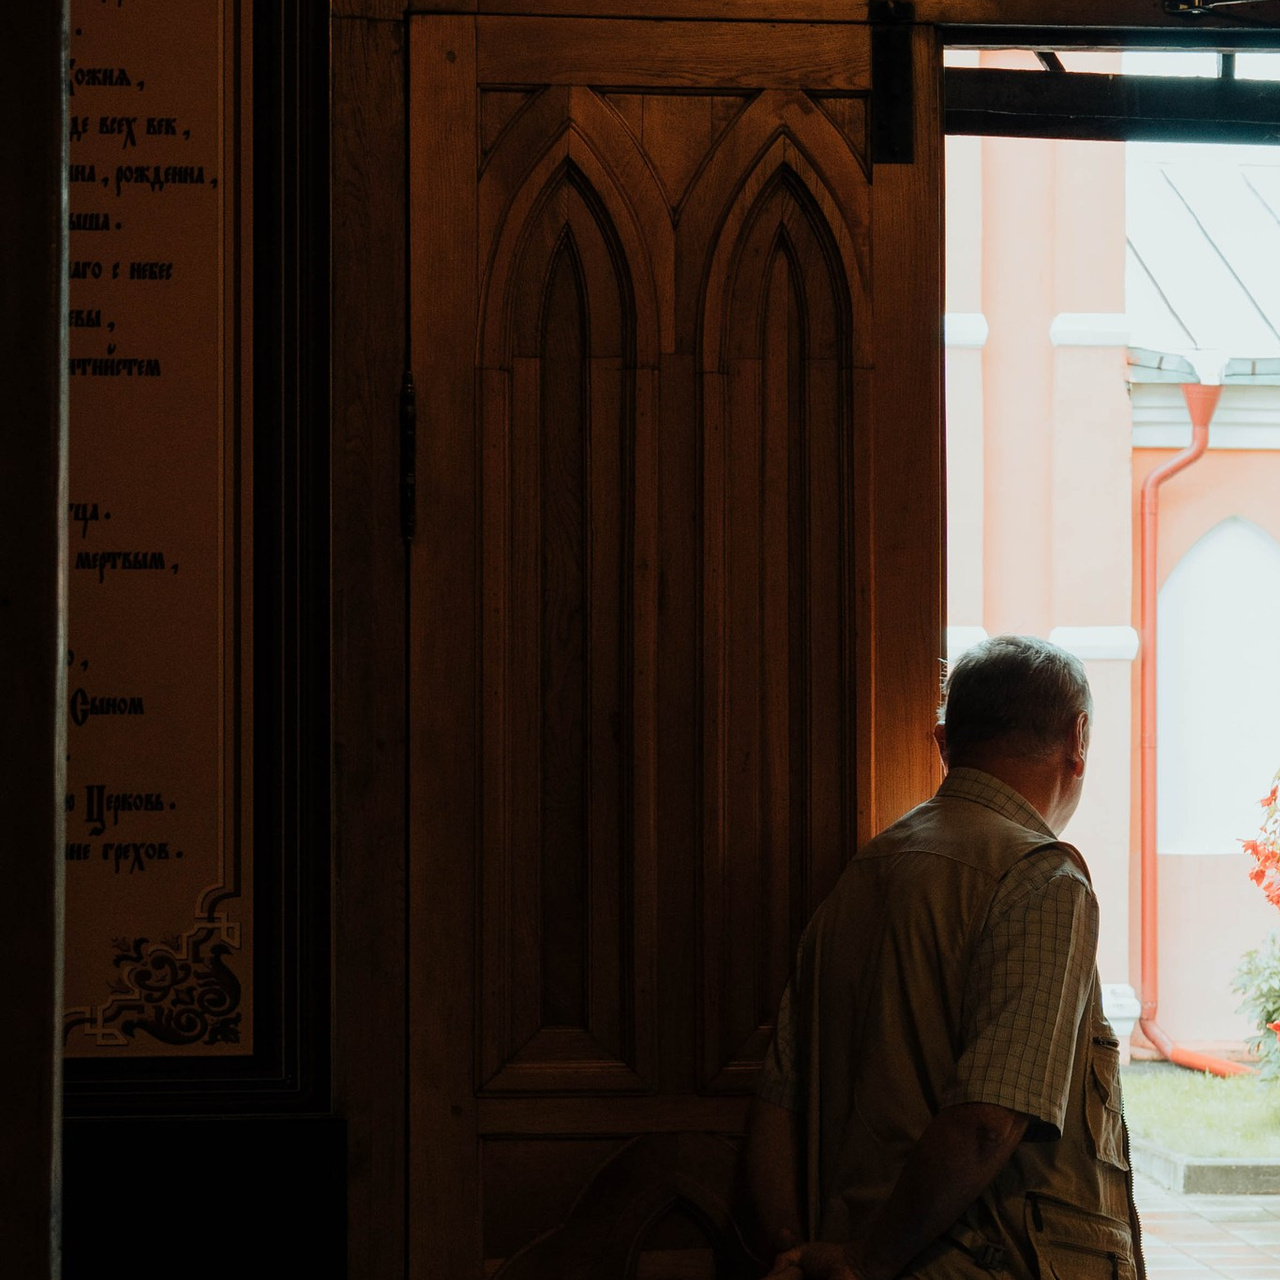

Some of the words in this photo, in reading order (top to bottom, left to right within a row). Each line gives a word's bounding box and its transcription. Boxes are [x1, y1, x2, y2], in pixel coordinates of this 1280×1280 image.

[68, 58, 145, 96] ожия,
[98, 116, 137, 149] всех
[69, 212, 122, 232] ыша.
[111, 261, 120, 280] с
[129, 262, 173, 281] небес
[74, 551, 179, 583] мертвым,
[69, 687, 145, 727] Сыном
[85, 784, 177, 836] Церковь.
[101, 842, 184, 874] грехов.
